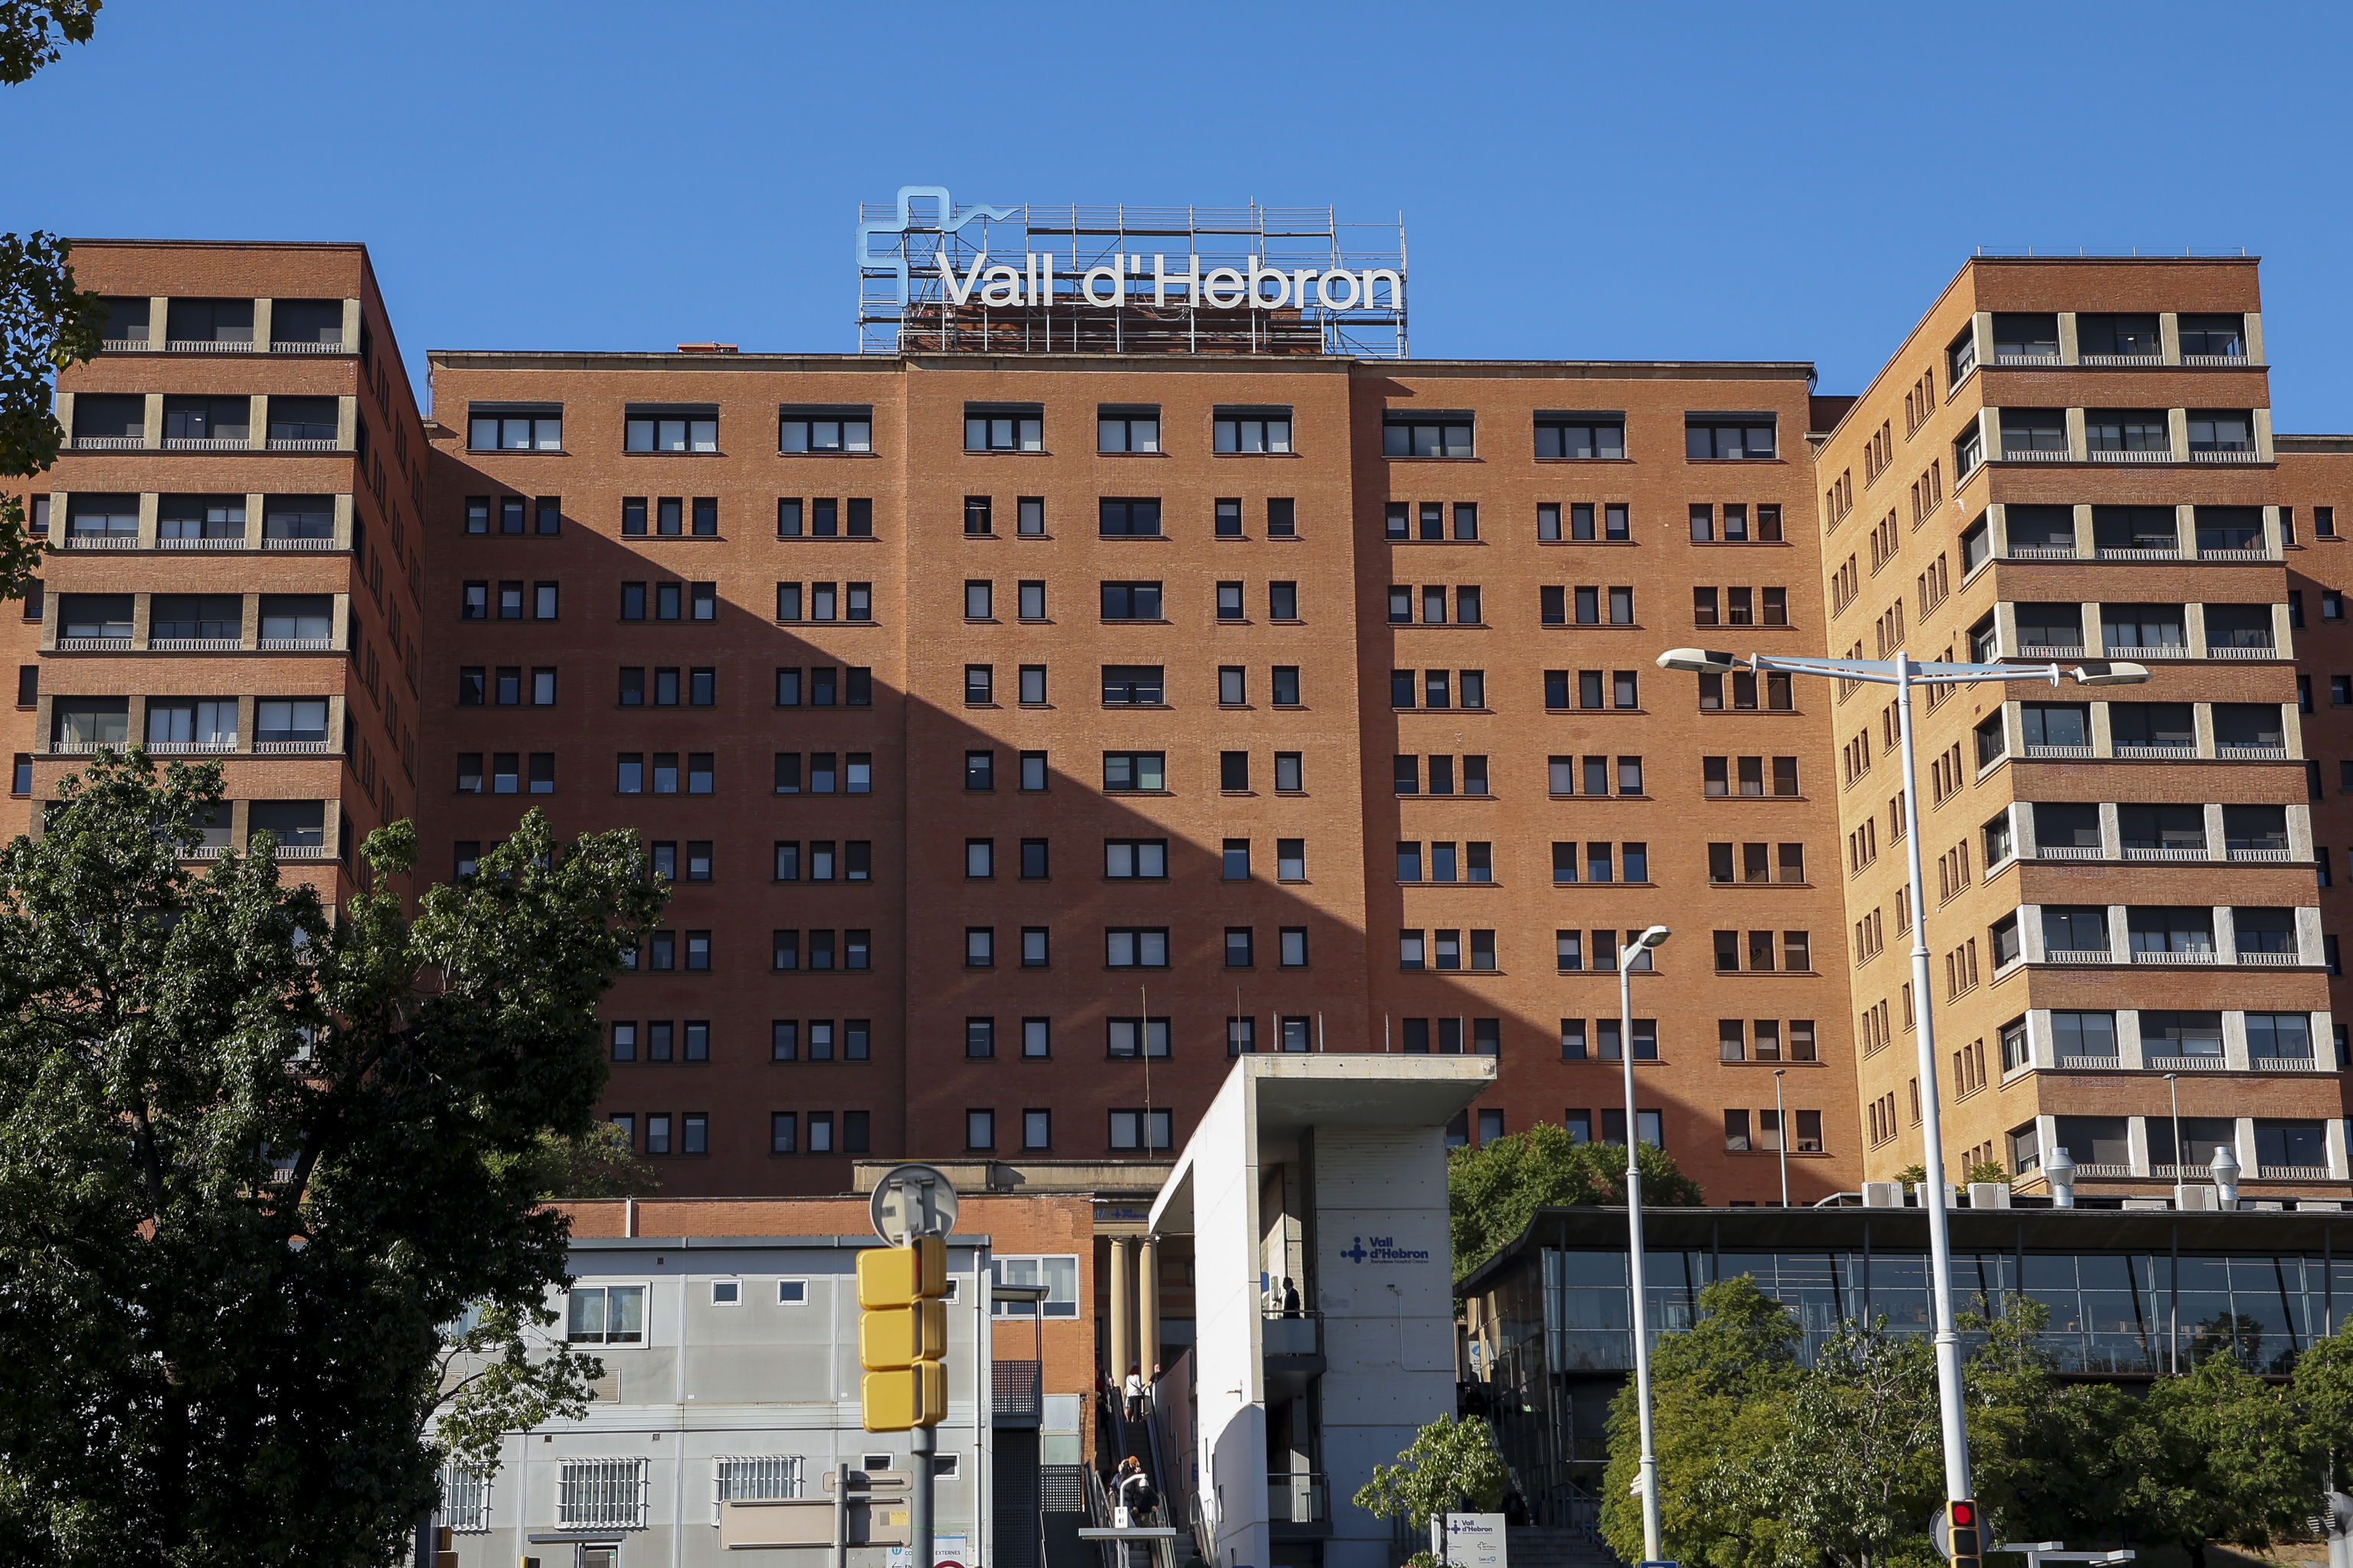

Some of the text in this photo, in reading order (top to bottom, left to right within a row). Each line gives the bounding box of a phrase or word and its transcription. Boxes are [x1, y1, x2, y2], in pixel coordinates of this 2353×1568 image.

[935, 253, 1402, 310] Vall d'Hebron
[1369, 1236, 1393, 1248] Vall
